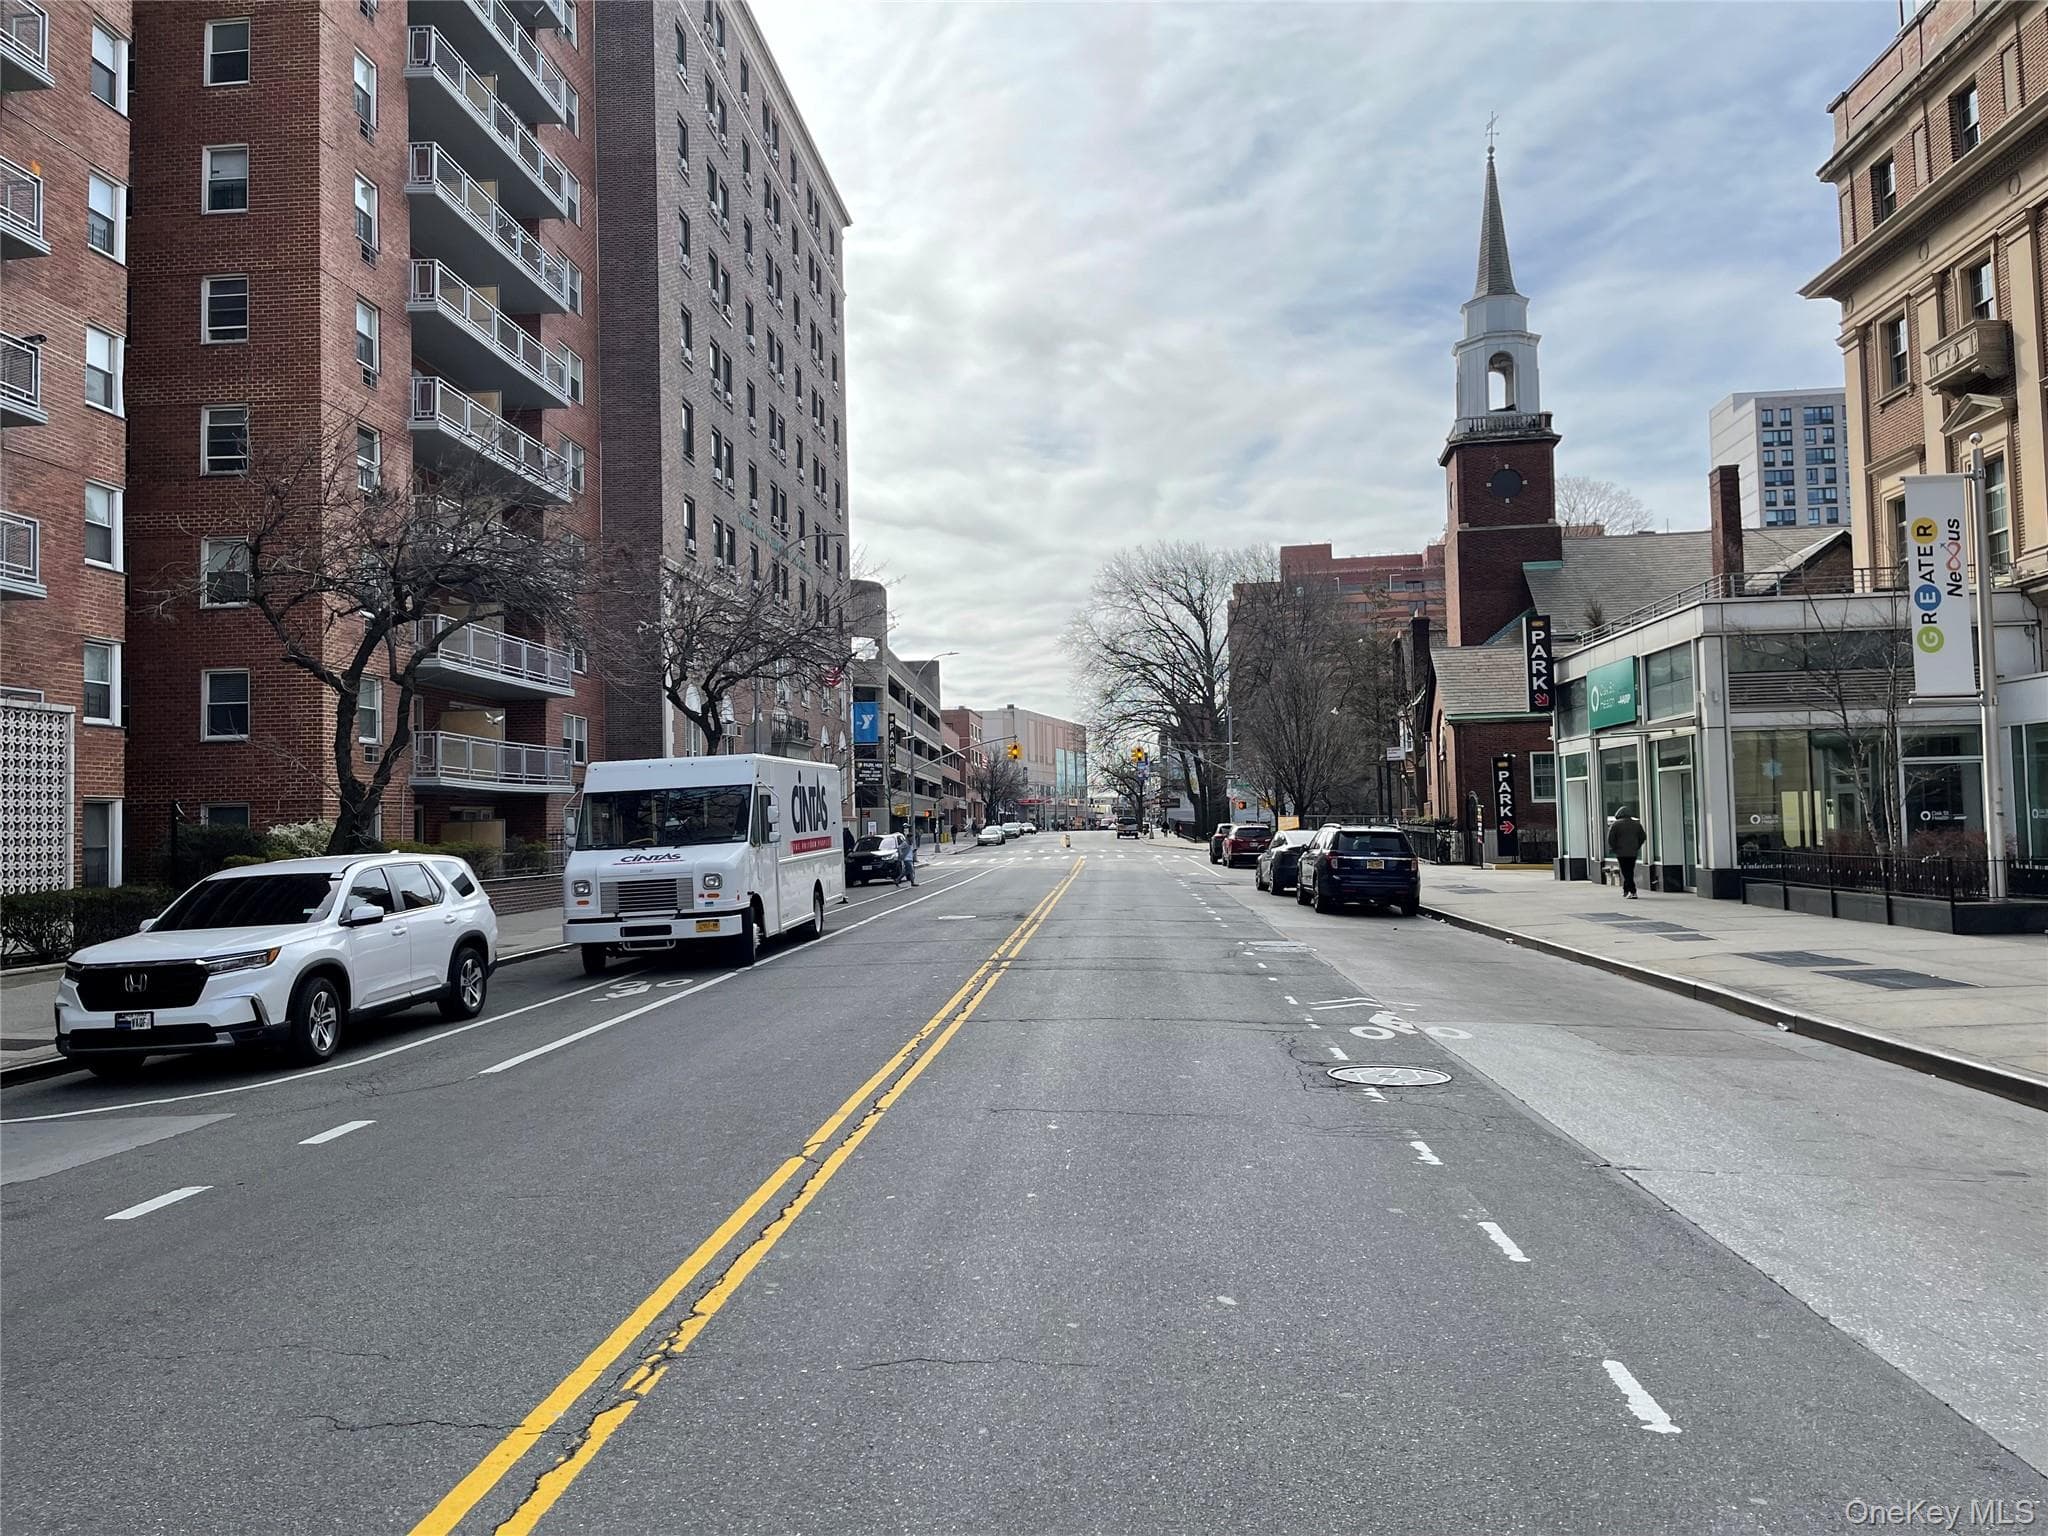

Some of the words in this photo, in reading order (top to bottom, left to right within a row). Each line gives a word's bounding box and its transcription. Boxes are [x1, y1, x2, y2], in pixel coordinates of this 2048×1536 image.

[1915, 521, 1941, 649] GREATER
[1531, 630, 1549, 691] PARK
[791, 770, 828, 834] CINTAS
[1498, 770, 1513, 817] PARK
[620, 853, 681, 862] CINTAS
